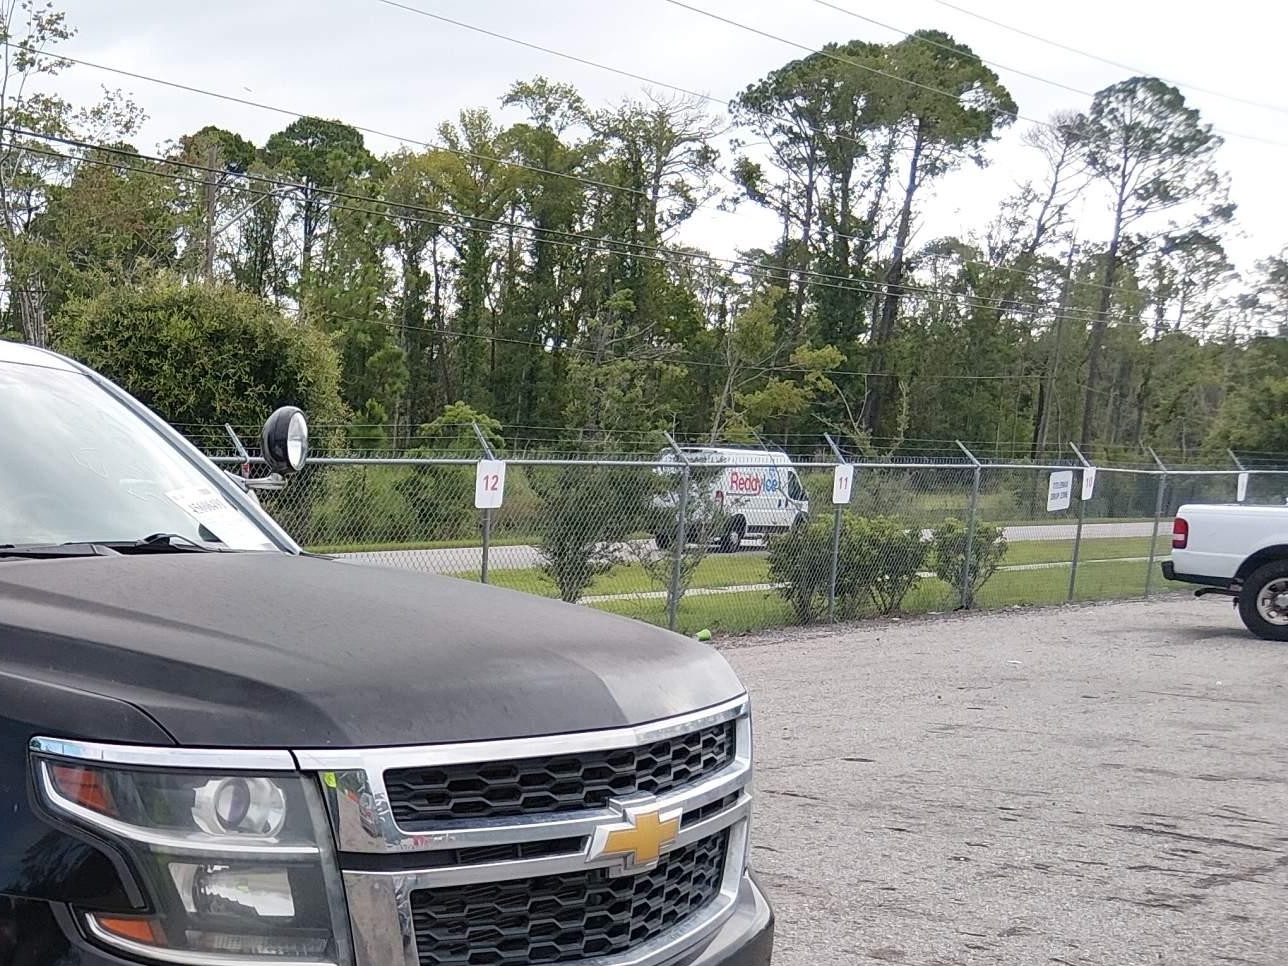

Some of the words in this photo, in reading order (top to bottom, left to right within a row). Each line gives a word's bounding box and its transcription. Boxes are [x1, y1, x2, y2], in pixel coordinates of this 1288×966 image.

[482, 474, 499, 491] 12
[839, 477, 848, 490] 11
[1086, 476, 1093, 488] 10
